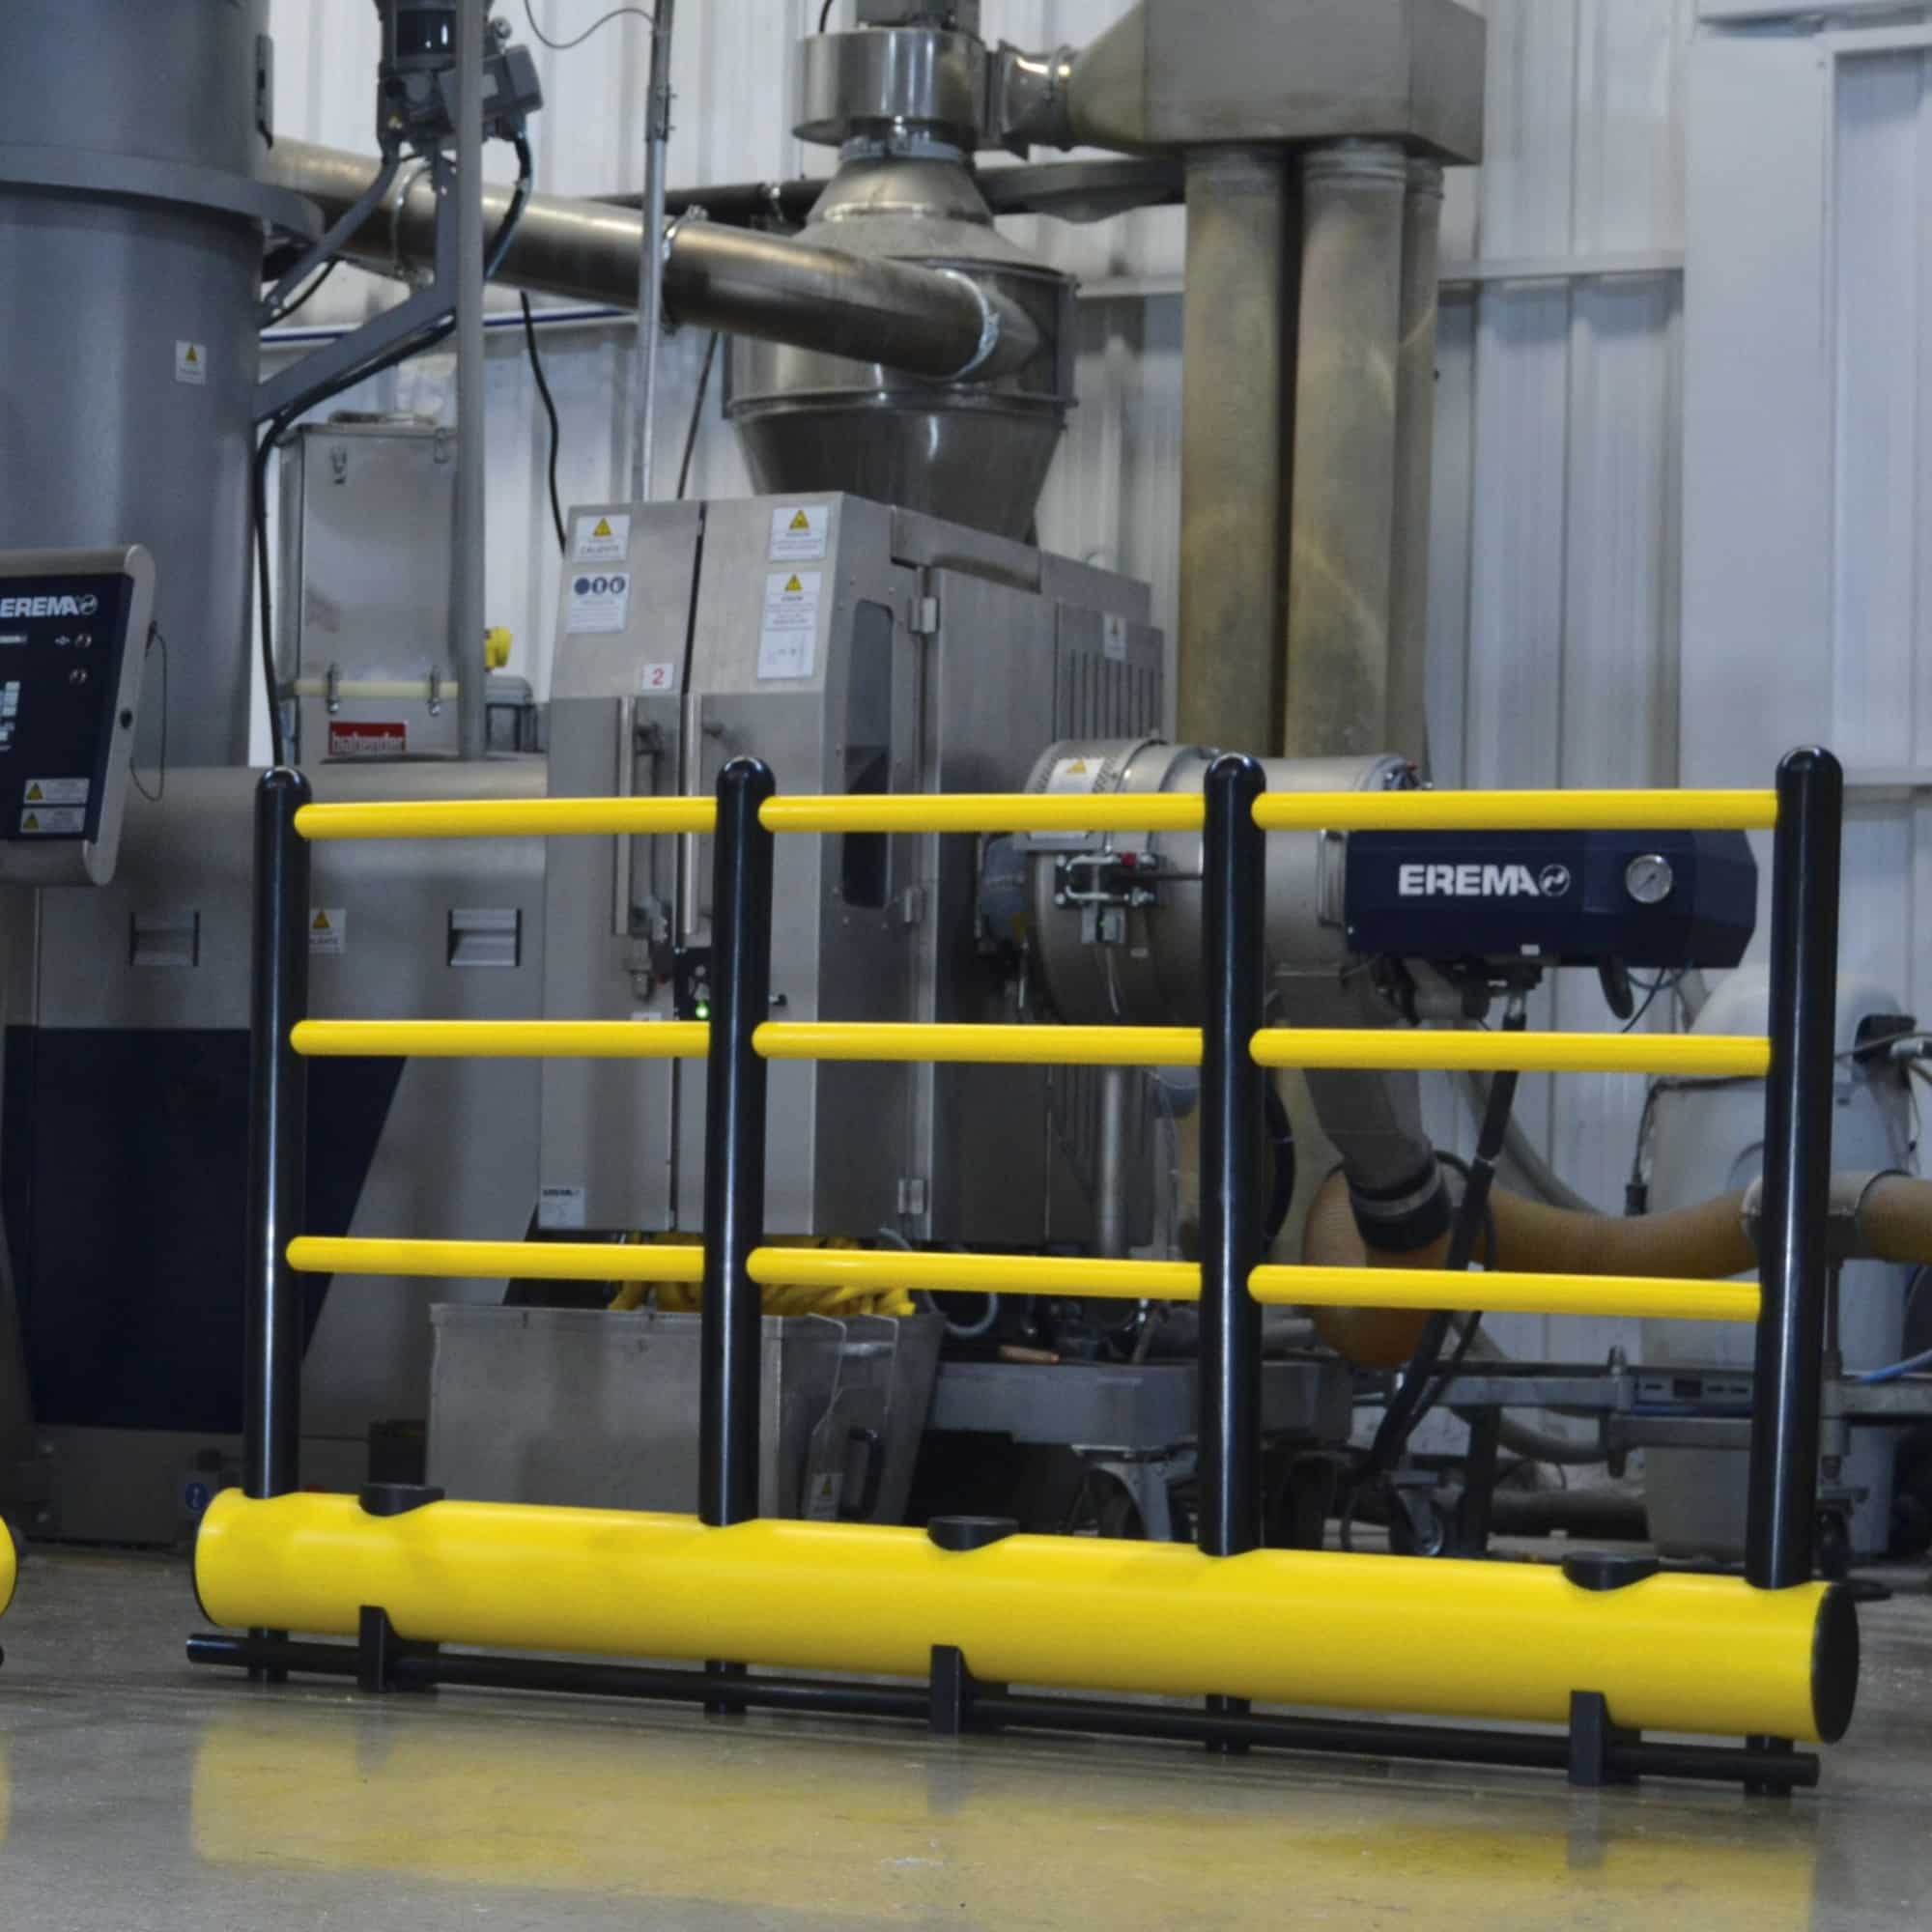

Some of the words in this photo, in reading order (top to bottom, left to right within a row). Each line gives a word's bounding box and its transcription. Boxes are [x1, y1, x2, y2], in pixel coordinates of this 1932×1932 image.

[0, 595, 79, 617] EREMA
[651, 668, 666, 686] 2
[1398, 864, 1540, 896] EREMA
